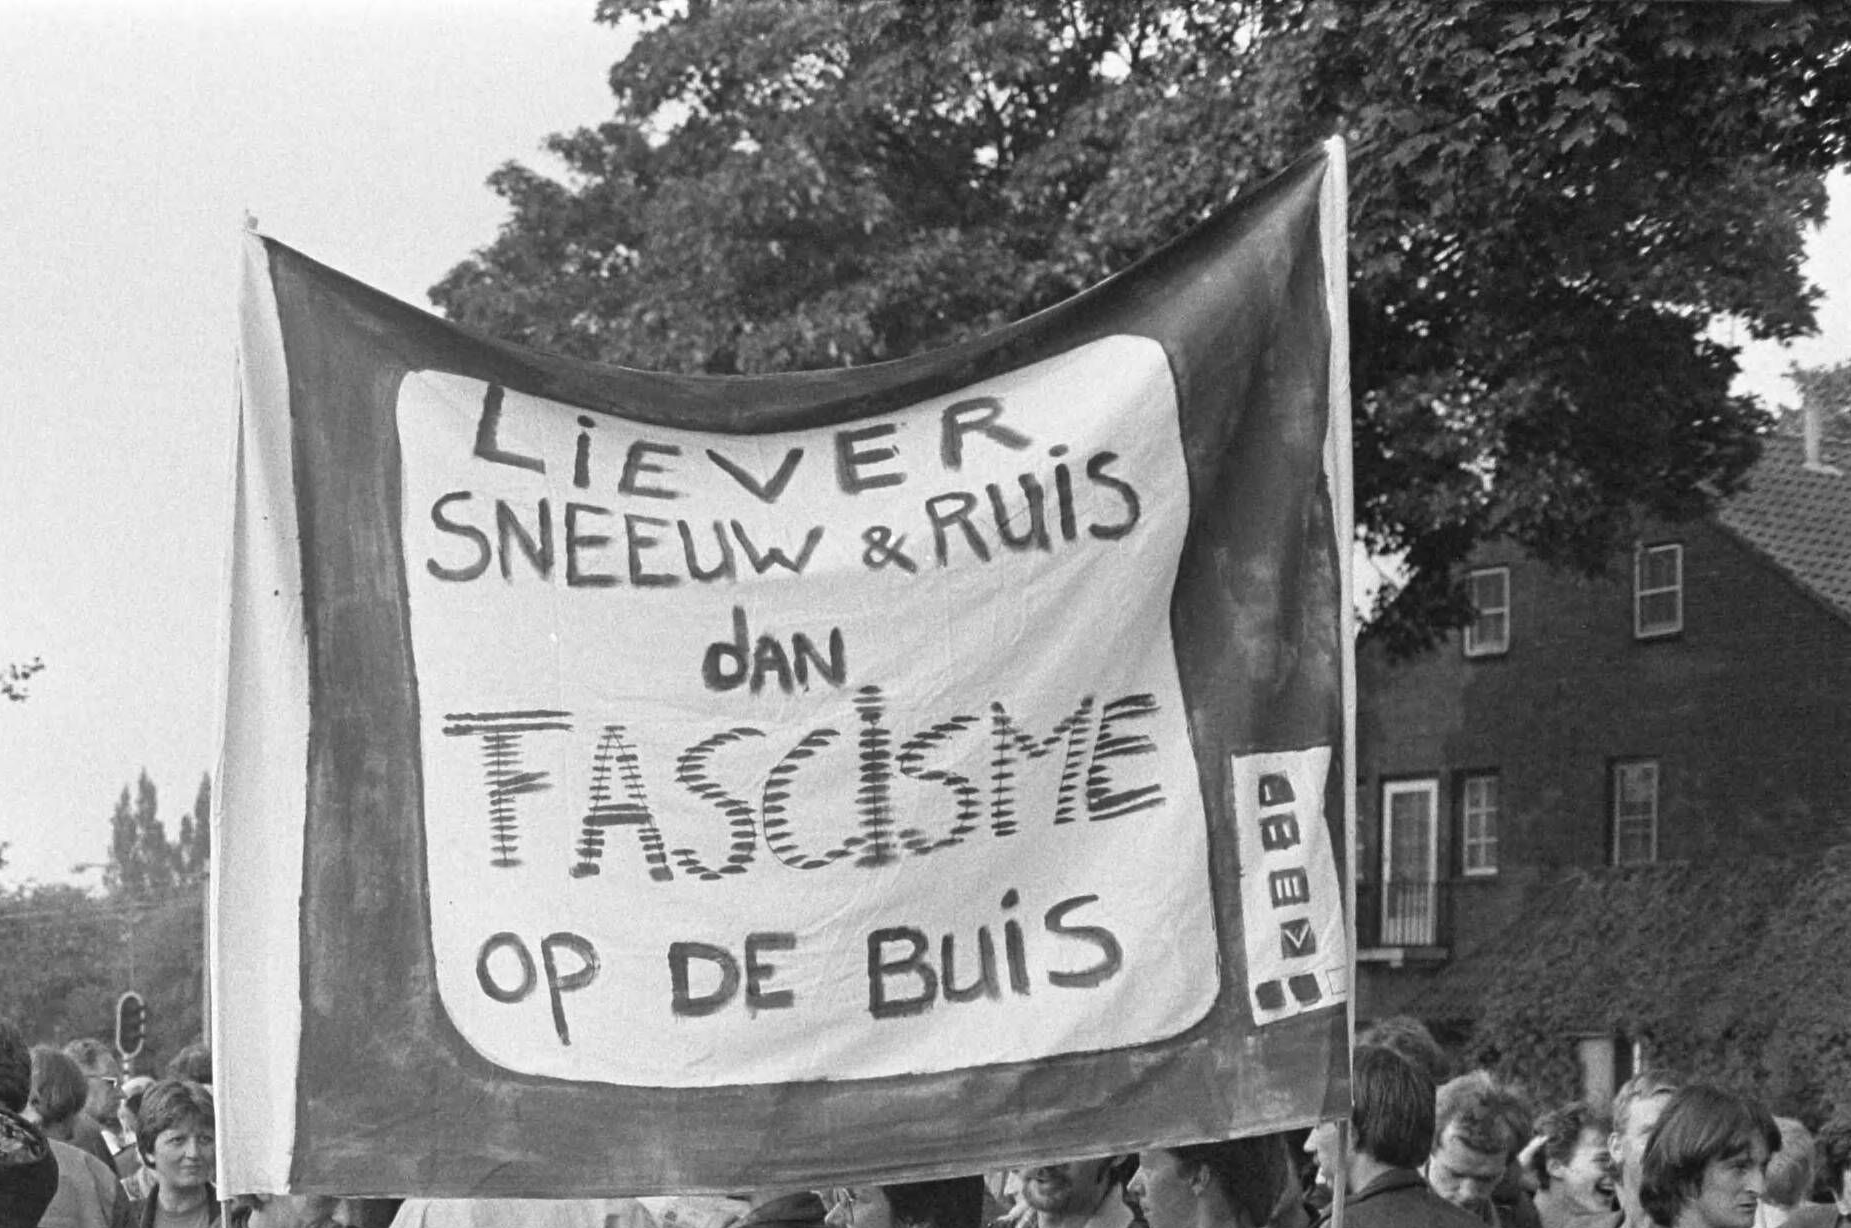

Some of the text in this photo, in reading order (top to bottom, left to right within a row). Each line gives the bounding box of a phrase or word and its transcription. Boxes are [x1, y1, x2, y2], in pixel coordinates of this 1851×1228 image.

[427, 491, 824, 587] SNEEUW
[862, 526, 917, 572] &
[476, 932, 597, 1045] OP
[670, 932, 798, 1016] DE
